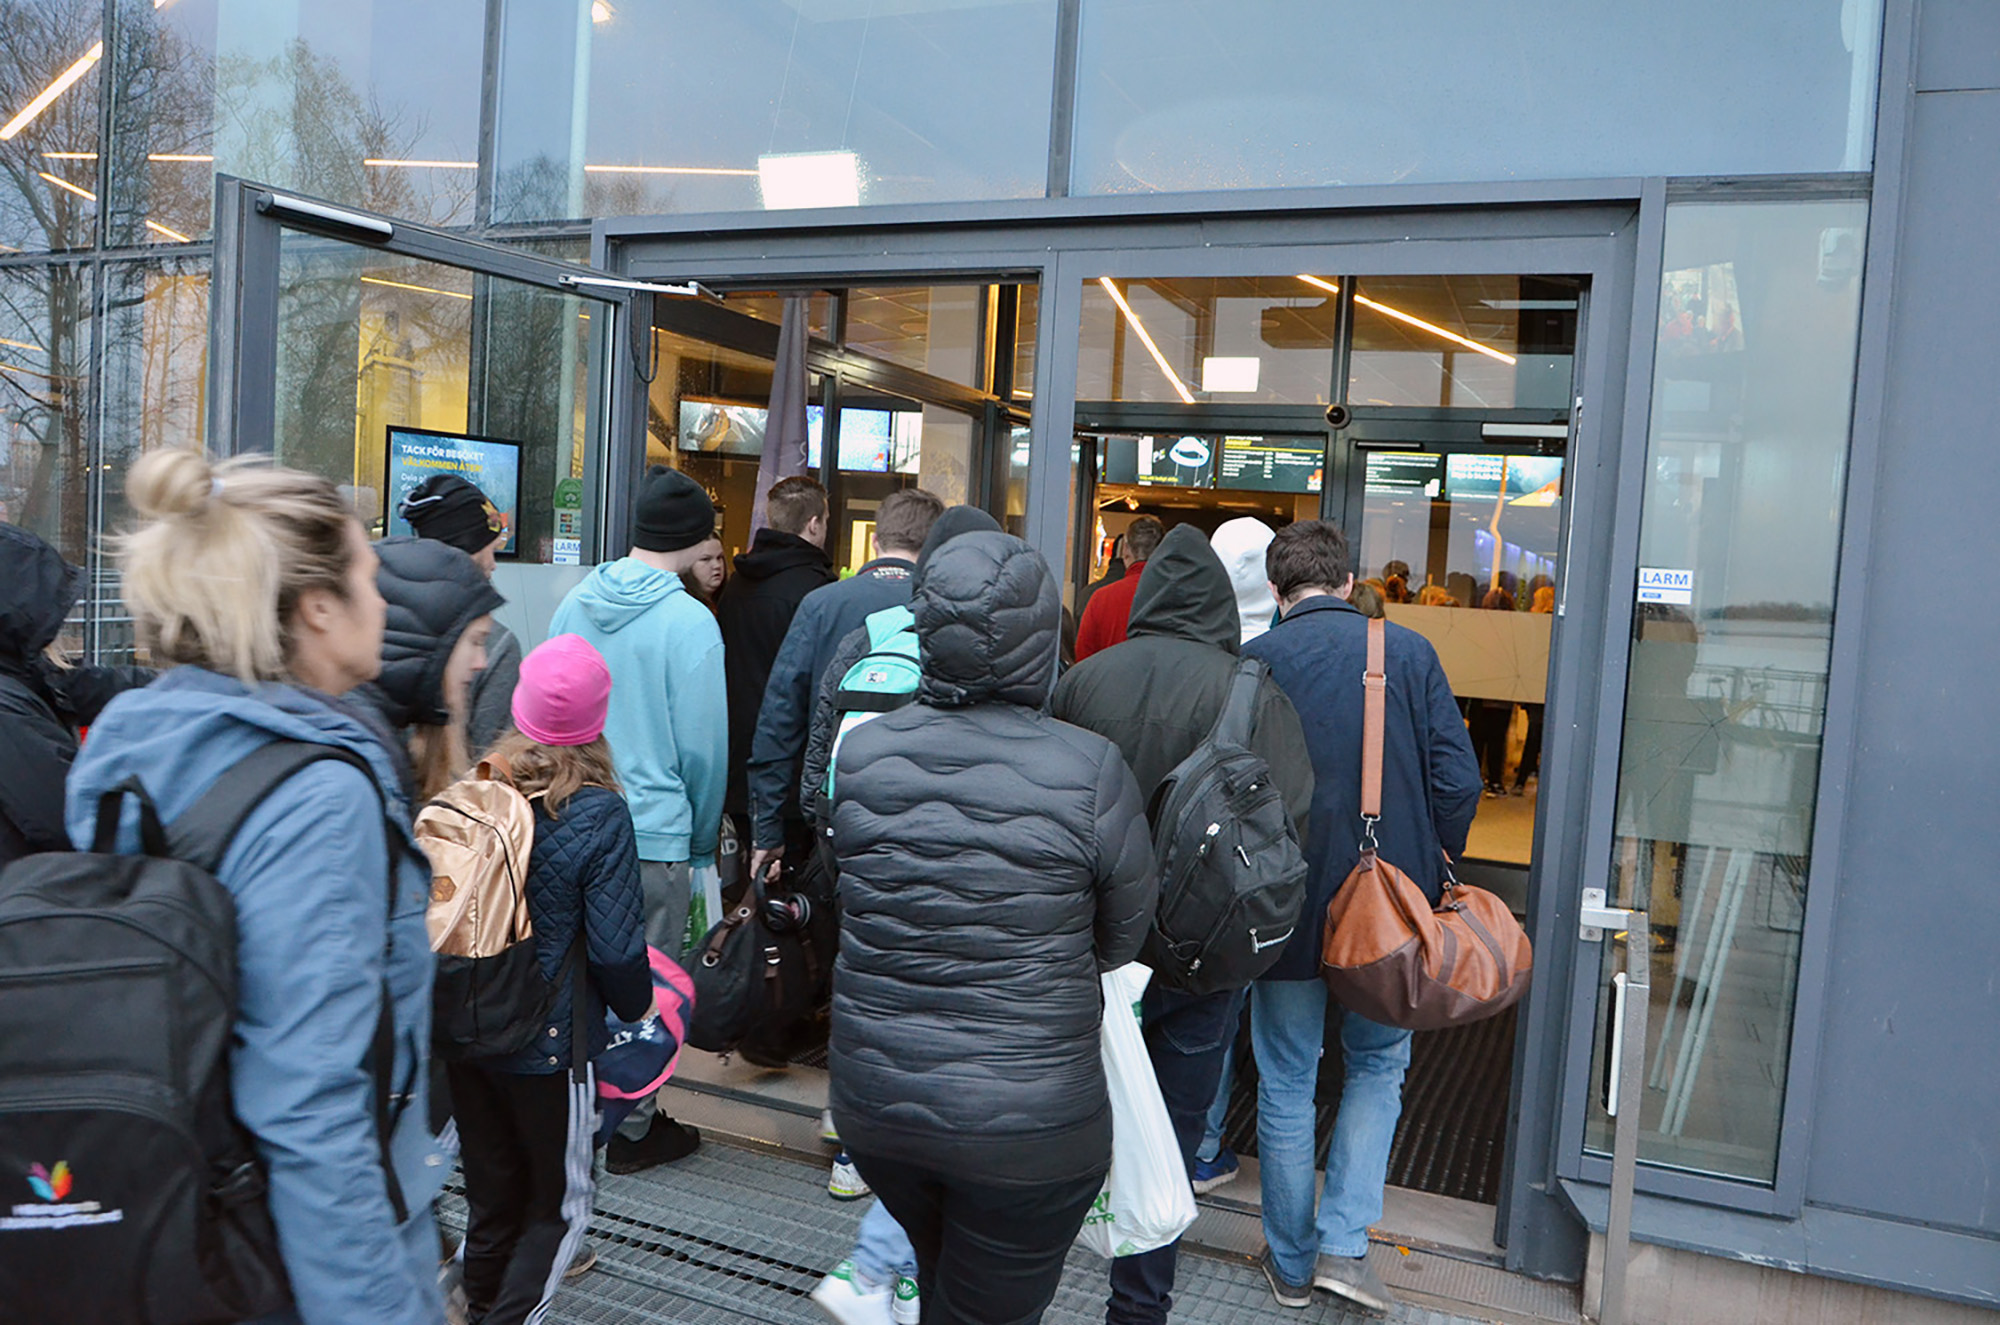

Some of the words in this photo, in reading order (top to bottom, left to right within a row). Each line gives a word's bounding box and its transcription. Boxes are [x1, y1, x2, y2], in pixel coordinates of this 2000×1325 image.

[401, 444, 426, 455] TACK
[427, 445, 445, 457] FÖR
[446, 448, 485, 461] BESÖKET
[401, 455, 458, 470] VÄLKOMMEN
[555, 542, 581, 552] LARM
[1643, 572, 1688, 585] LARM
